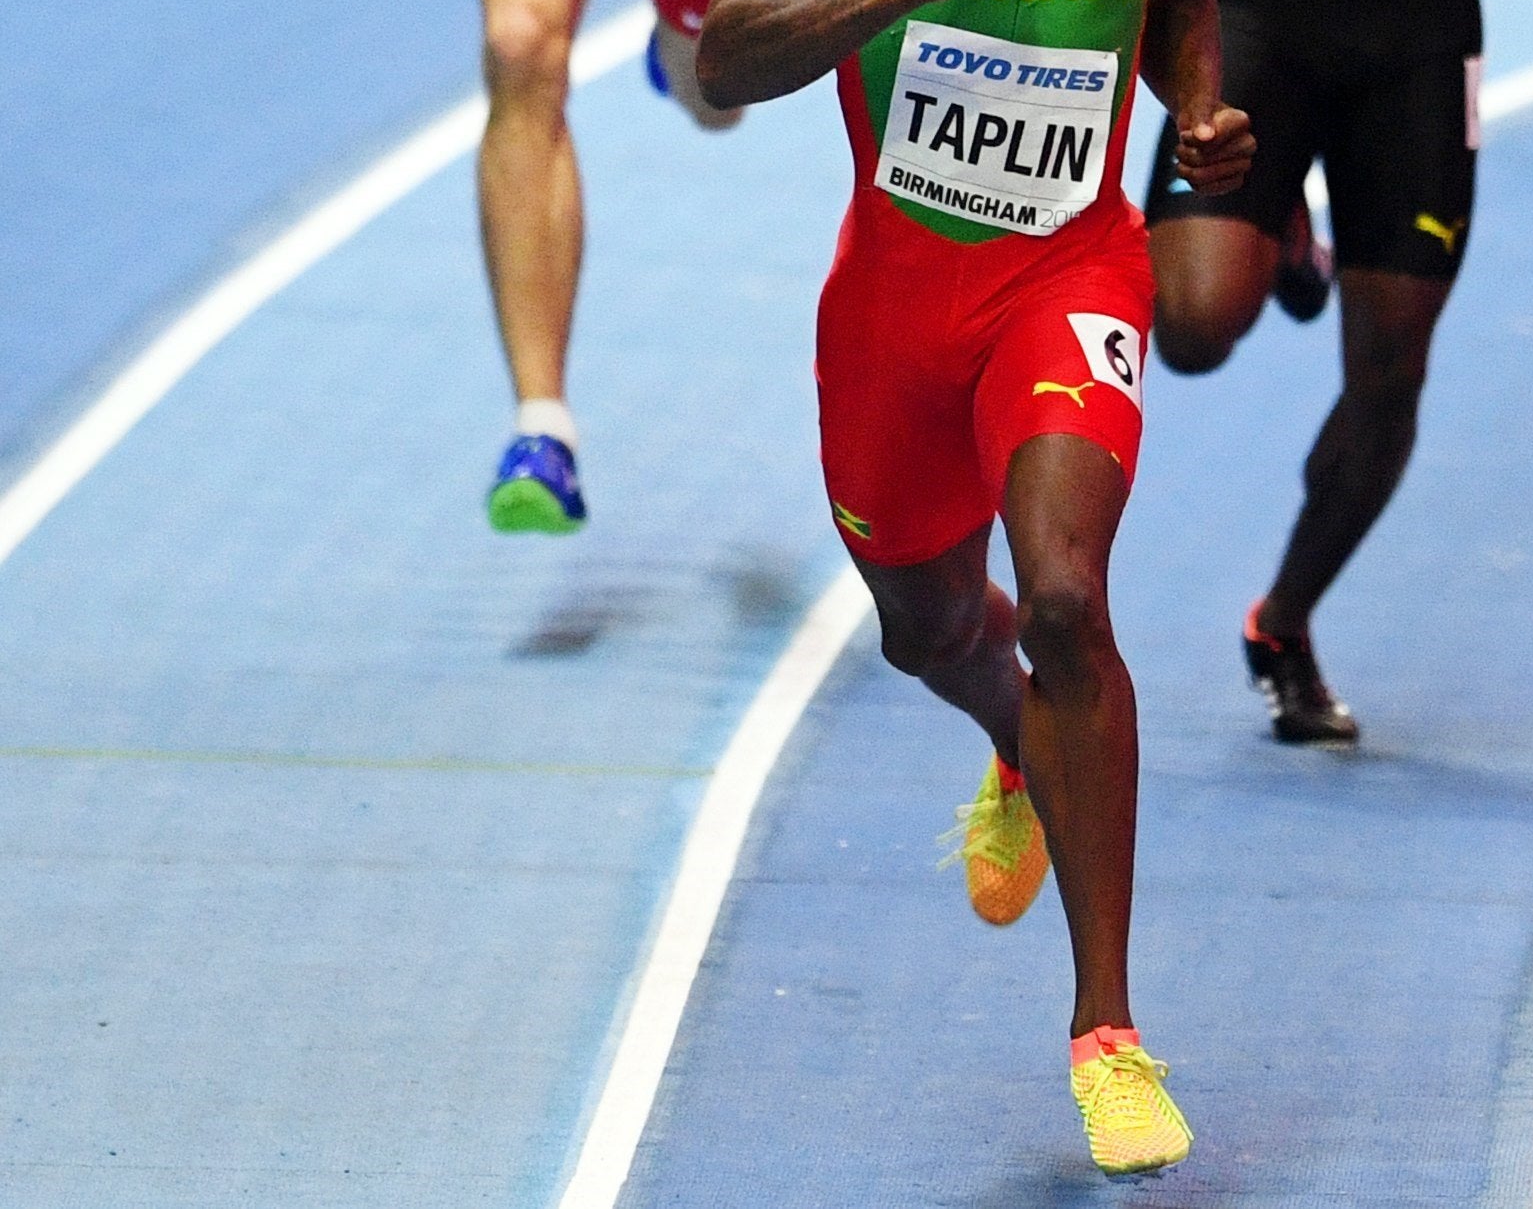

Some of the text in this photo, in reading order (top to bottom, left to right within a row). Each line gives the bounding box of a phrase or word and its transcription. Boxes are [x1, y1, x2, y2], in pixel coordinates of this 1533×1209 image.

[917, 41, 1109, 93] TOYO TIRES
[904, 90, 1094, 183] TAPLIN
[889, 165, 1037, 227] BIRMINGHAM
[1104, 329, 1133, 387] 6
